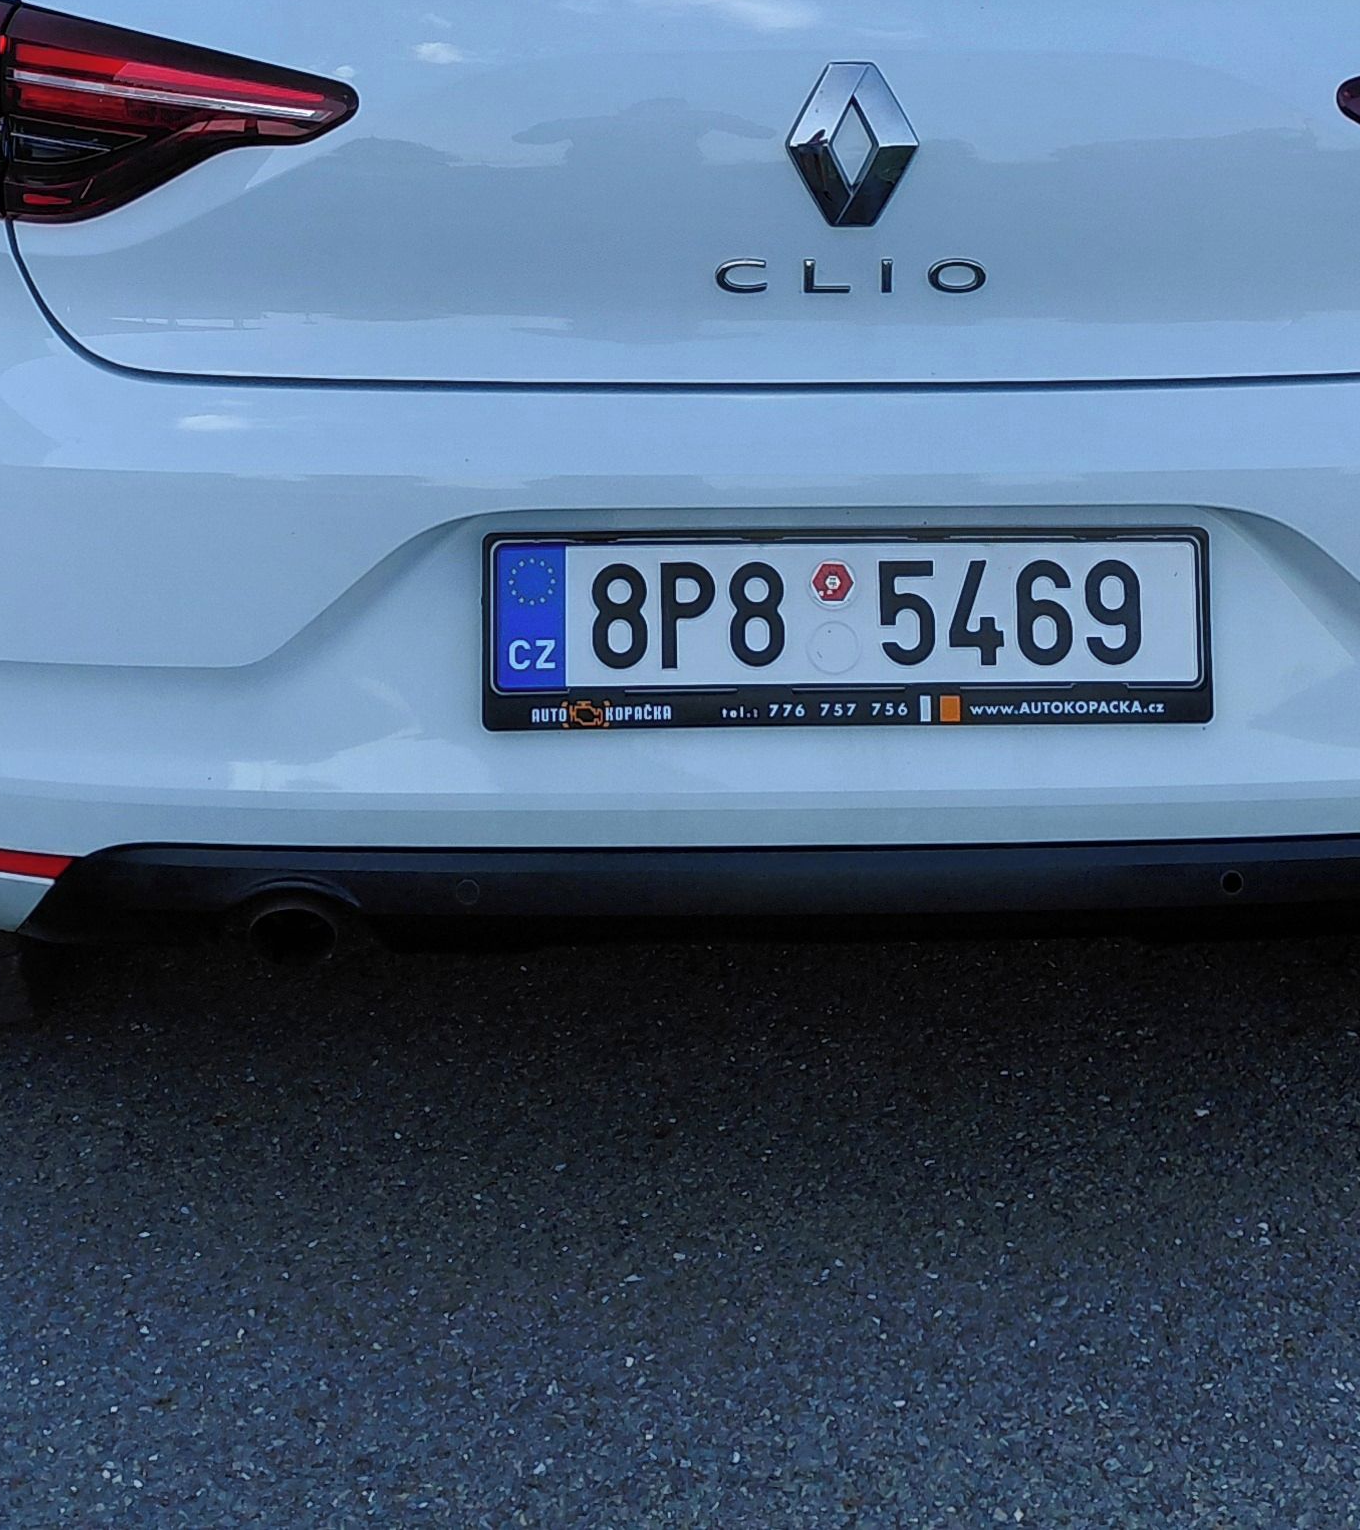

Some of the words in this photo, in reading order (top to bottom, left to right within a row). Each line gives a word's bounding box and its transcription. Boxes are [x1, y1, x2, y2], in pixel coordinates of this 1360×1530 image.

[715, 257, 987, 294] CLIO
[591, 561, 786, 670] 8P8
[878, 559, 1141, 666] 5469
[508, 639, 556, 670] CZ
[531, 708, 567, 723] AUTO
[605, 703, 672, 721] KOPAČKA
[768, 703, 806, 718] 776
[820, 703, 857, 717] 757
[871, 702, 909, 717] 756
[969, 700, 1165, 717] www.AUTOKOPACKA.cz
